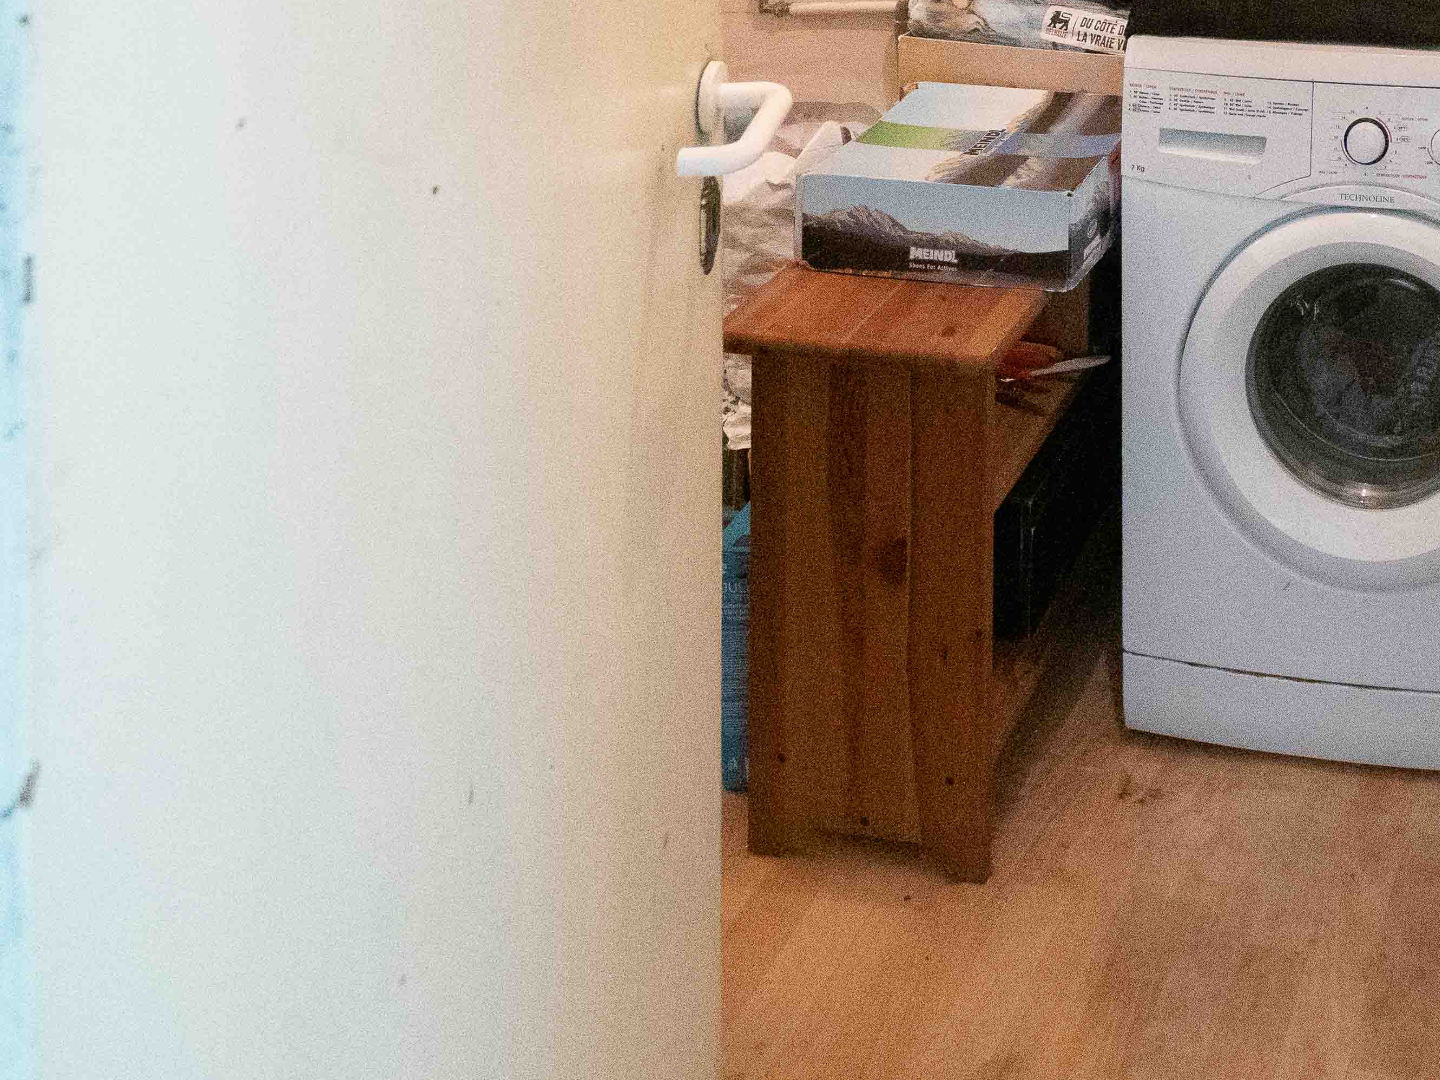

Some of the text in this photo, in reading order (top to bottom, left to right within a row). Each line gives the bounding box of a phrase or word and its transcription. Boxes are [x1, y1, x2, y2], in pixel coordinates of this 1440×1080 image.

[1080, 17, 1126, 36] DU CÔTÉ D
[1077, 31, 1087, 43] LA
[1090, 33, 1115, 49] VRAIE
[963, 128, 1006, 155] MEINDL
[1339, 193, 1395, 204] TECHNOLINE
[909, 246, 959, 263] MEINDL
